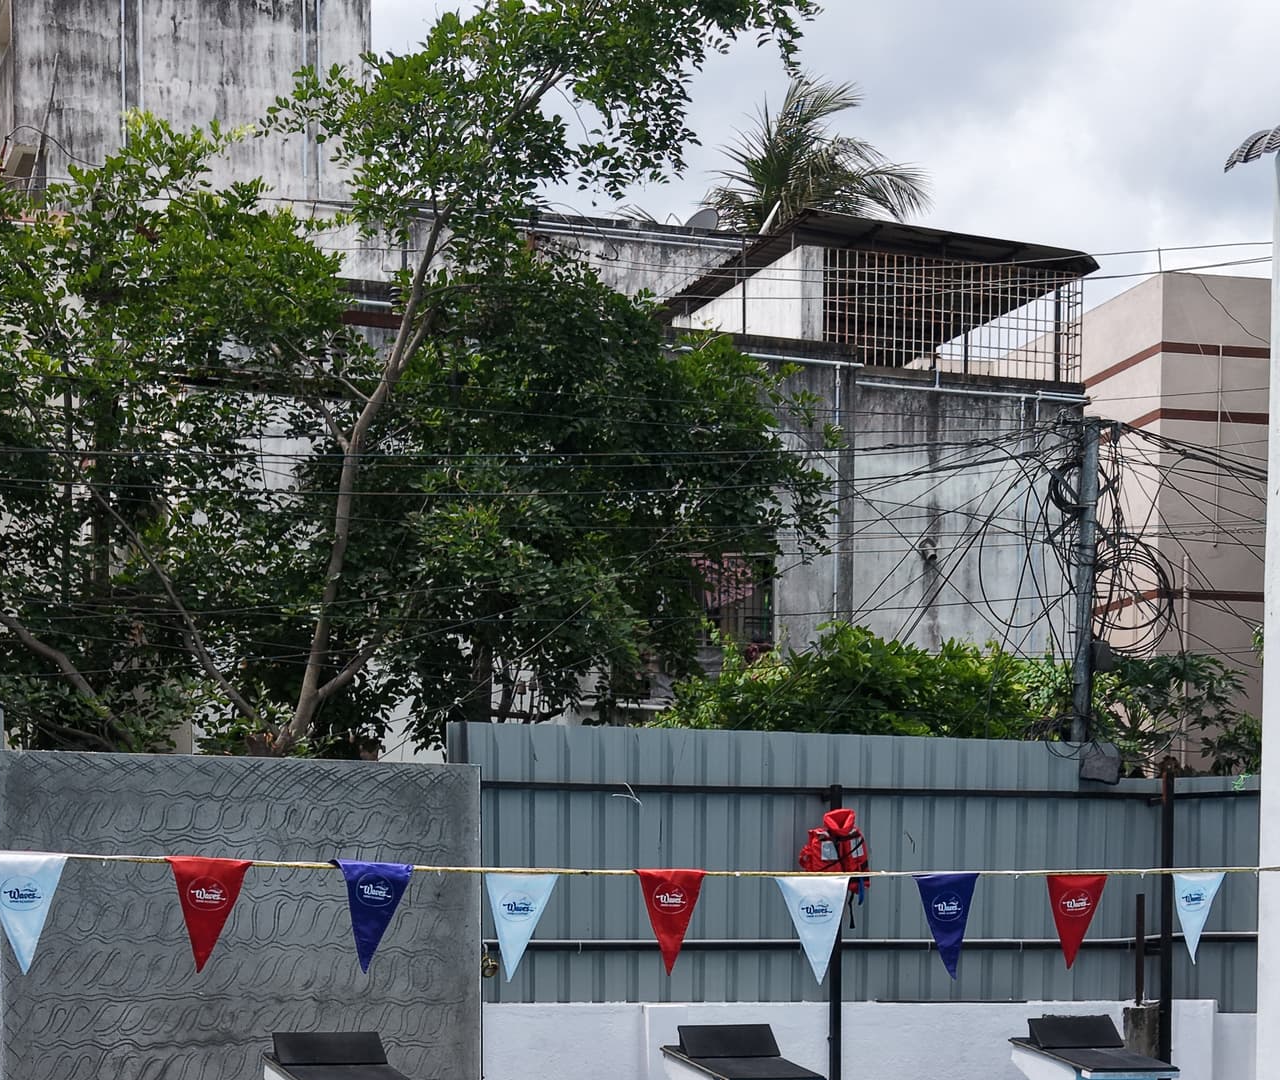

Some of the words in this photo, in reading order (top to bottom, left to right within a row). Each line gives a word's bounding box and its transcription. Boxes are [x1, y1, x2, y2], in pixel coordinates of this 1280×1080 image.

[3, 888, 41, 900] Waves
[190, 888, 226, 901] Waves
[359, 884, 391, 898] Waves
[656, 893, 686, 904] Waves
[801, 904, 833, 915] Waves
